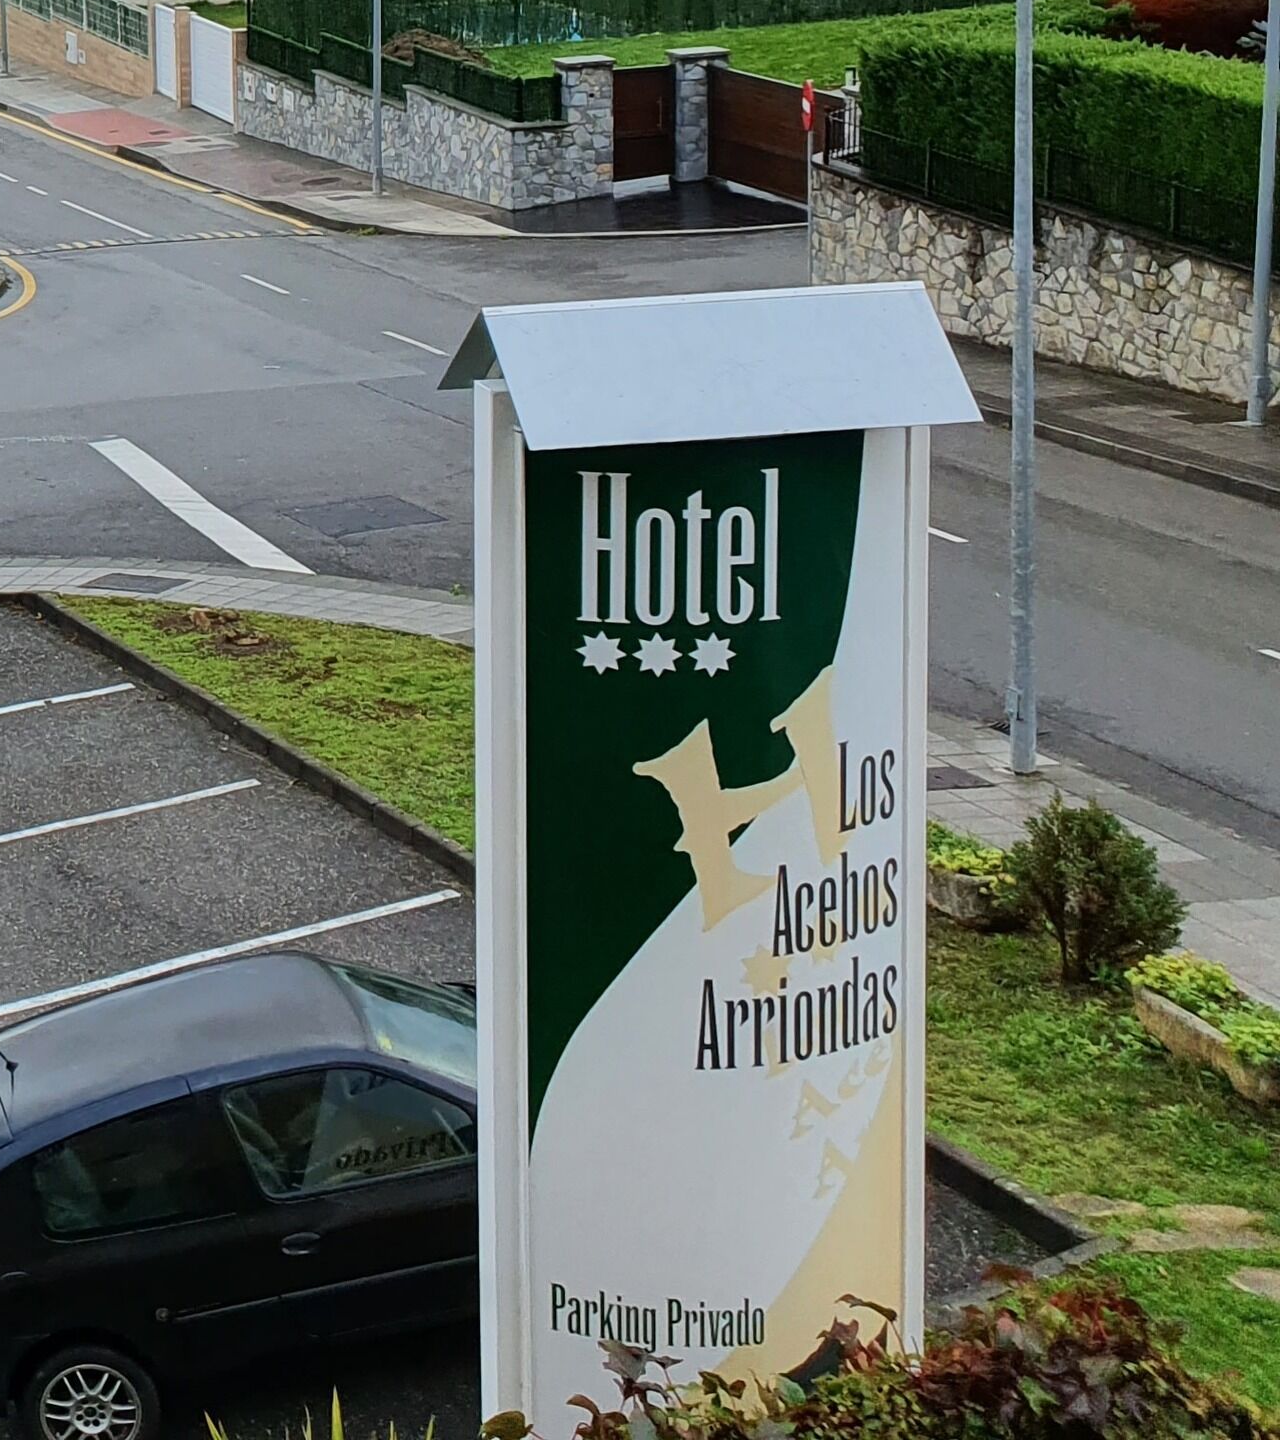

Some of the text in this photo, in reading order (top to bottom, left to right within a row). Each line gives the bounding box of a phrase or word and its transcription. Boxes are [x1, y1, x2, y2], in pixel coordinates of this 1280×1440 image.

[576, 467, 781, 626] Hotel
[838, 740, 896, 833] Los
[772, 851, 899, 958] Acebos
[695, 956, 899, 1071] Arriondas
[551, 1282, 766, 1355] Parking Privado
